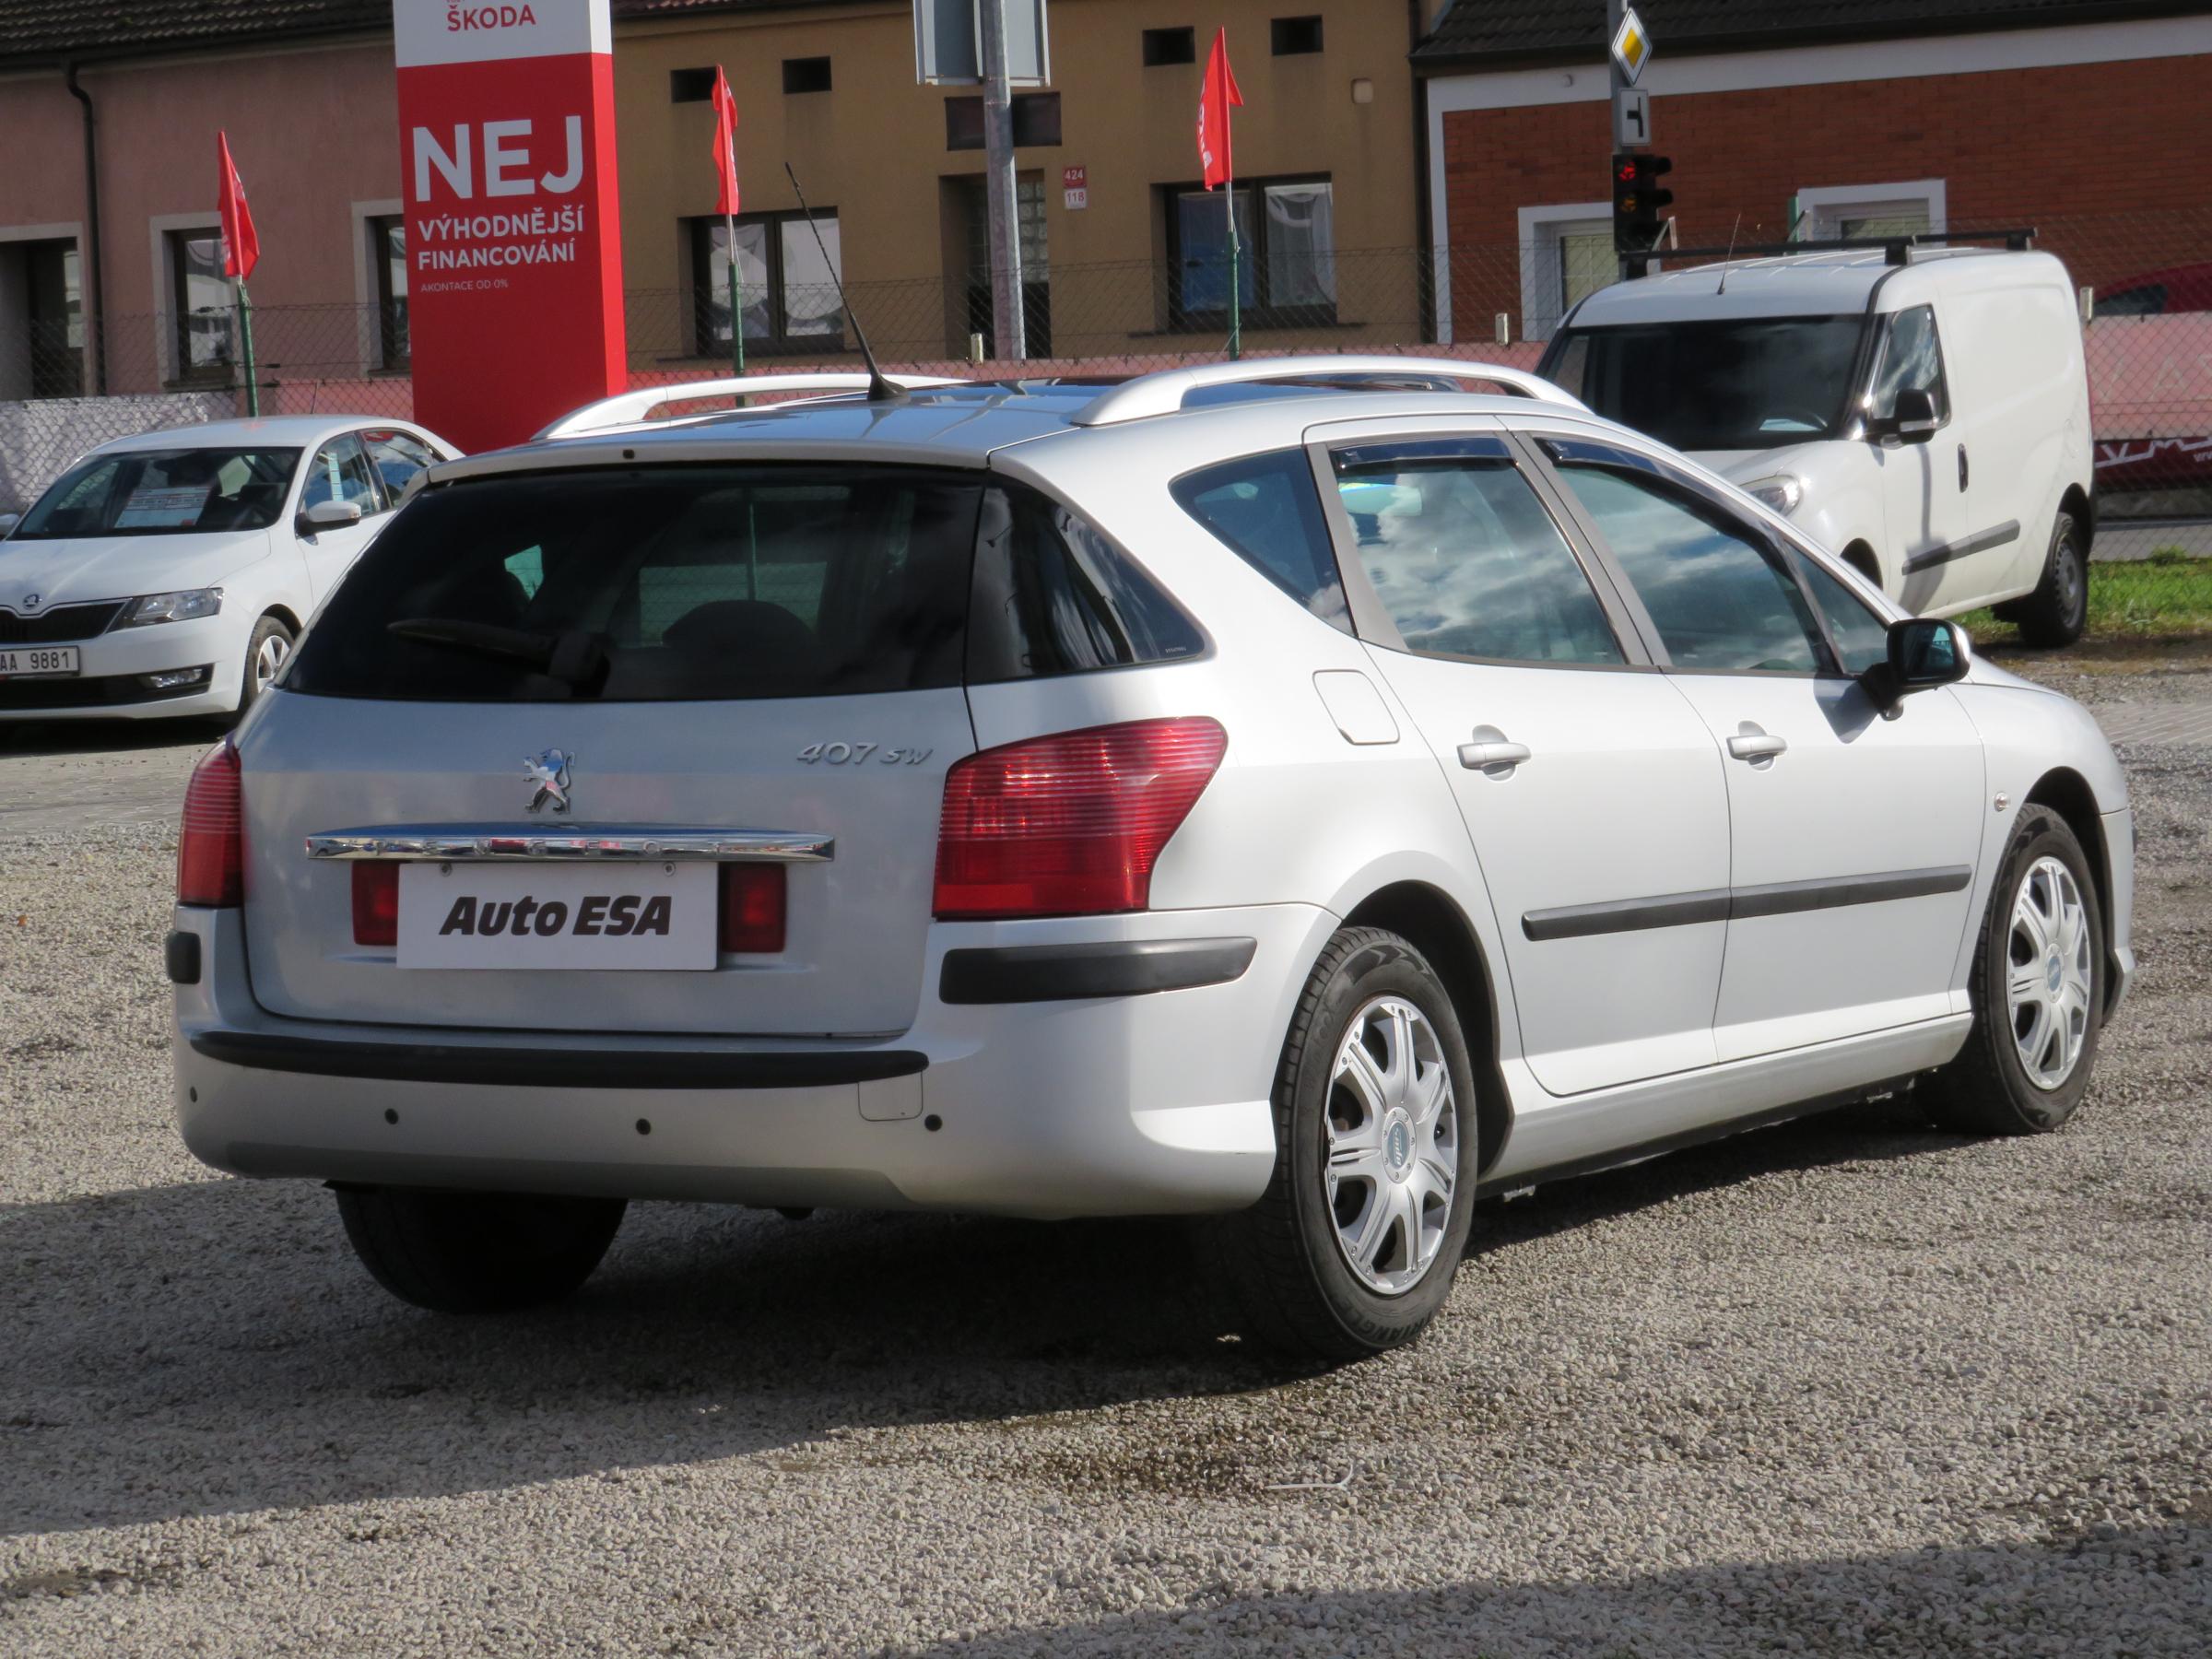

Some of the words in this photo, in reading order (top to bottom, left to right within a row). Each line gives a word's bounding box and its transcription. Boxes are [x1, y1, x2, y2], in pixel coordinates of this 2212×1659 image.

[447, 4, 537, 31] ŠKODA
[412, 115, 583, 203] NEJ
[1064, 168, 1084, 181] 424
[418, 204, 584, 242] VÝHODNĚJŠÍ
[418, 237, 576, 271] FINANCOVÁNÍ
[420, 280, 474, 293] AKONTACE
[476, 279, 491, 290] OD
[493, 278, 510, 288] 0%
[29, 650, 69, 670] 9881
[796, 741, 878, 766] 407
[879, 747, 934, 766] SW
[438, 895, 569, 937] Auto
[571, 895, 673, 936] ESA
